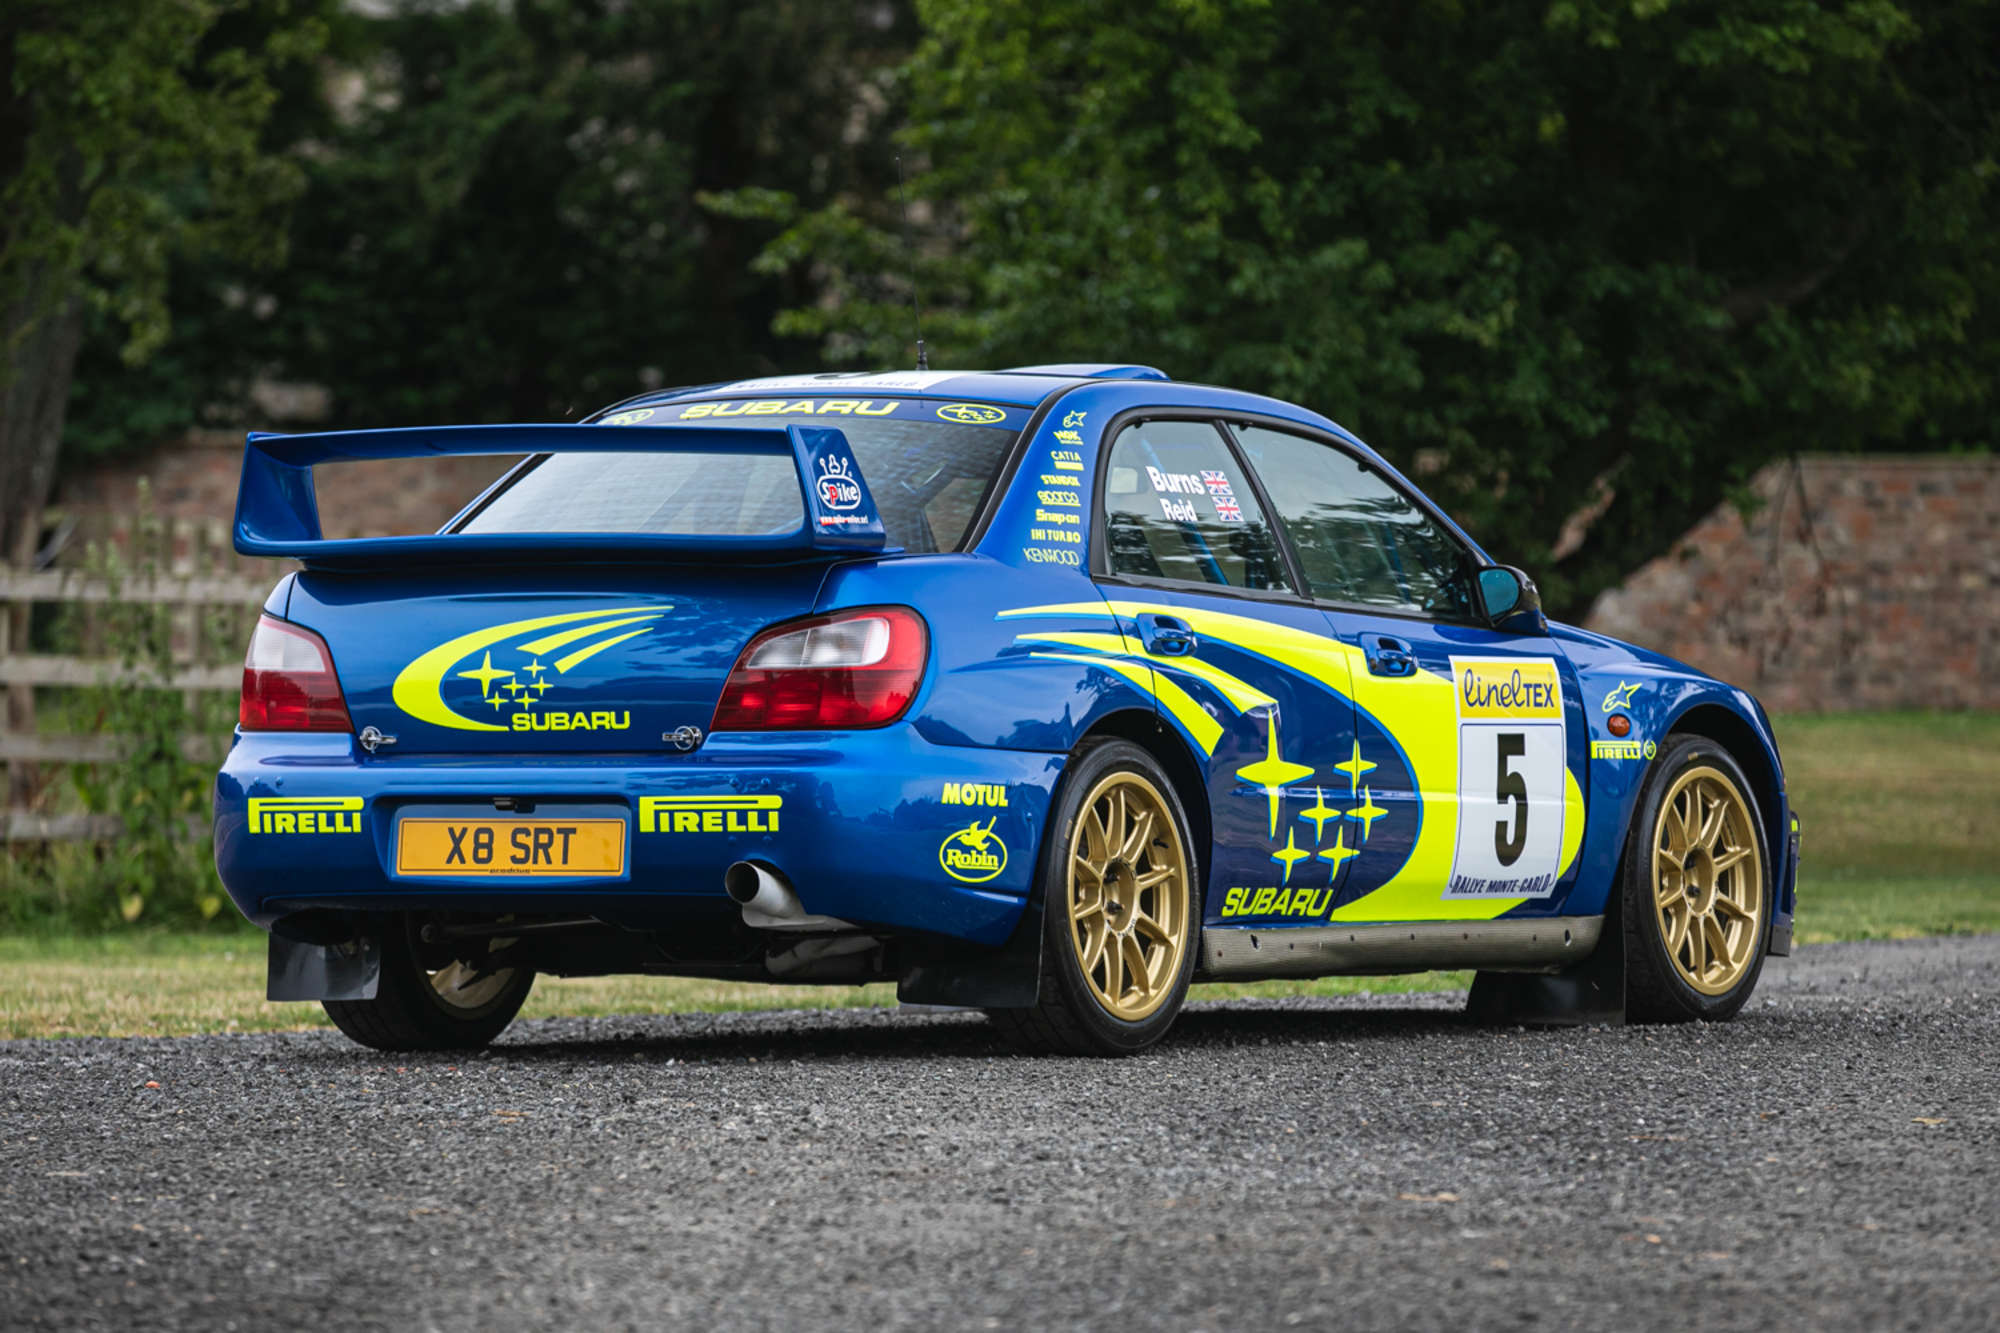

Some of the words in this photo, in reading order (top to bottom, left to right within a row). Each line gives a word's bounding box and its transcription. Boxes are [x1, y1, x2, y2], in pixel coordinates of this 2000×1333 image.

[679, 400, 900, 420] SUBARU
[1050, 450, 1082, 462] CATIA
[1145, 466, 1206, 495] Burns
[822, 482, 858, 505] Spike
[1035, 508, 1081, 526] Snap-on
[1160, 498, 1198, 522] Reid
[1030, 528, 1046, 541] IHI
[1046, 528, 1081, 544] TURBO
[1022, 547, 1080, 566] KENWOOD
[511, 710, 631, 732] SUBARU
[1591, 740, 1641, 760] PIRELLI
[941, 781, 1009, 807] MOTUL
[1494, 733, 1529, 867] 5
[248, 796, 364, 834] PIRELLI
[638, 794, 783, 833] PIRELLI
[445, 826, 496, 866] X8
[509, 826, 578, 866] SRT
[945, 848, 999, 870] Robin
[1450, 874, 1488, 894] RALLYE
[1221, 886, 1334, 917] SUBARU
